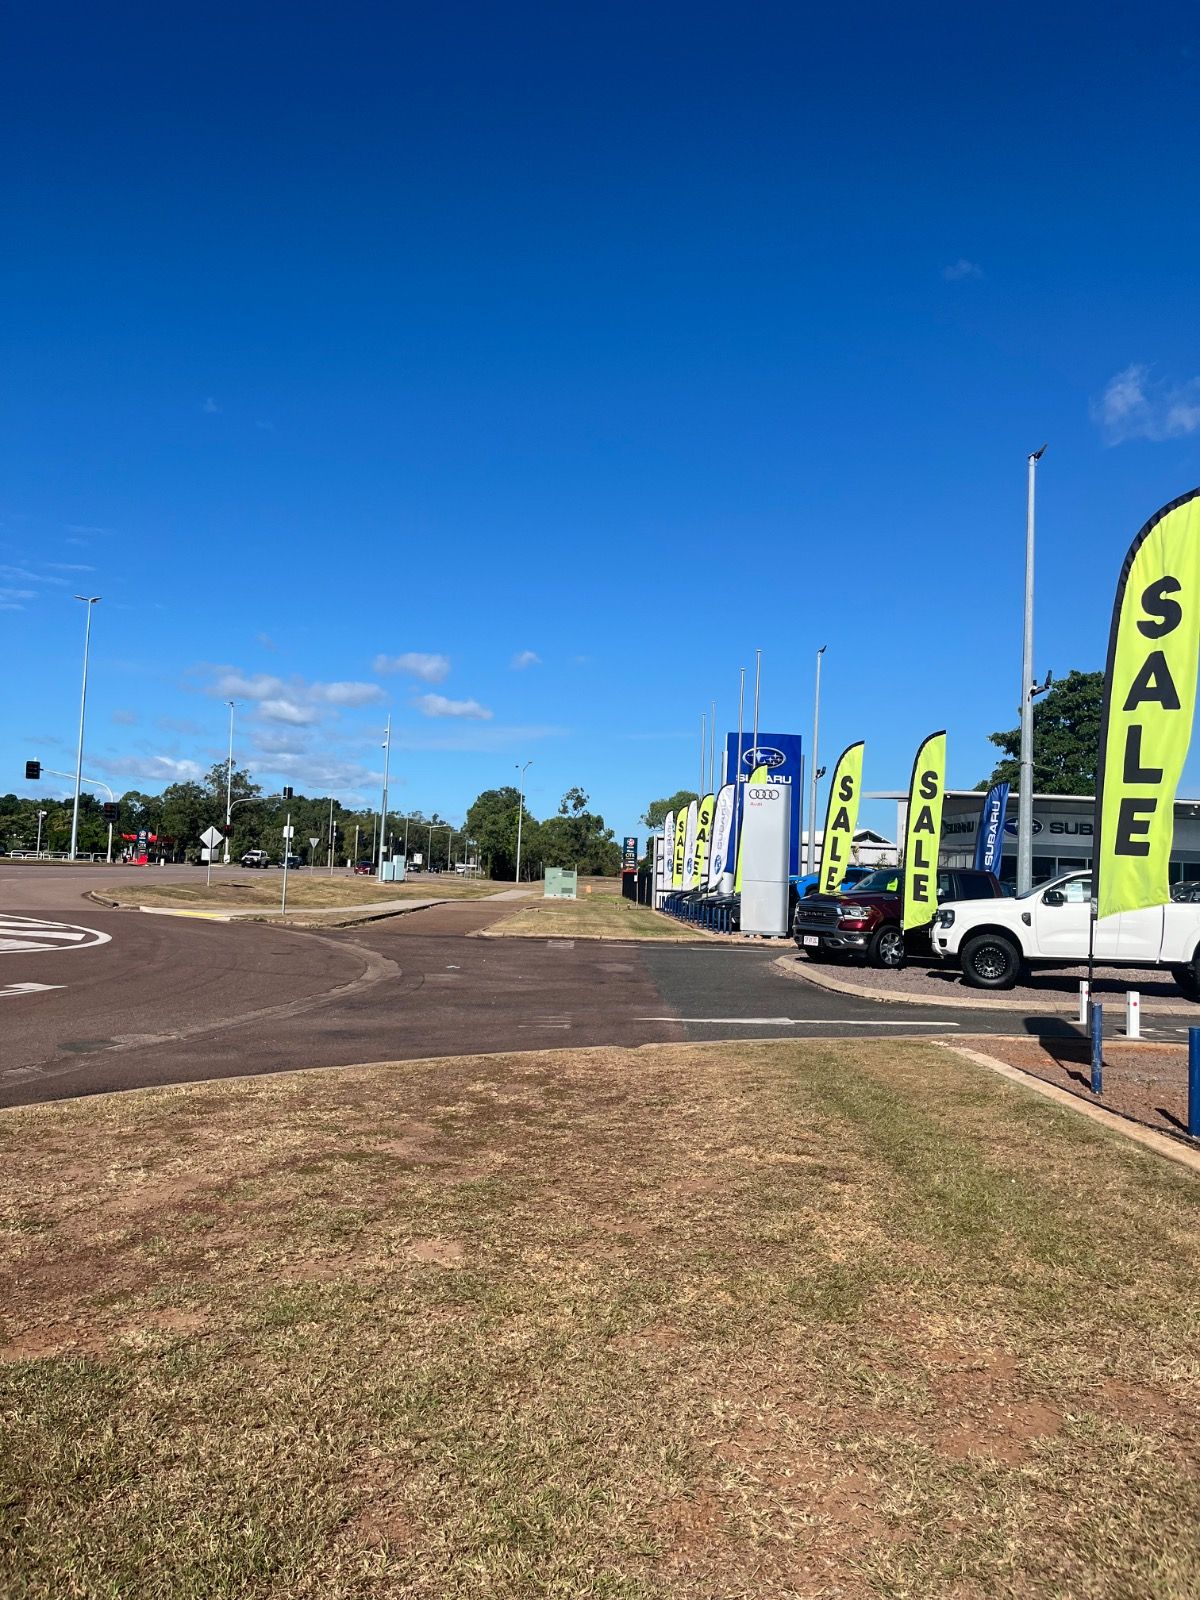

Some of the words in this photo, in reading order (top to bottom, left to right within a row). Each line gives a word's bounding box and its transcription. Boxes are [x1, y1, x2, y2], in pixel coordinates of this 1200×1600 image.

[1115, 575, 1183, 856] SALE
[736, 773, 792, 784] SARU
[676, 821, 684, 875] SALE
[826, 775, 854, 890] SALE
[913, 771, 939, 902] SALE
[984, 800, 1001, 866] SUBARU
[1050, 822, 1094, 835] SUB
